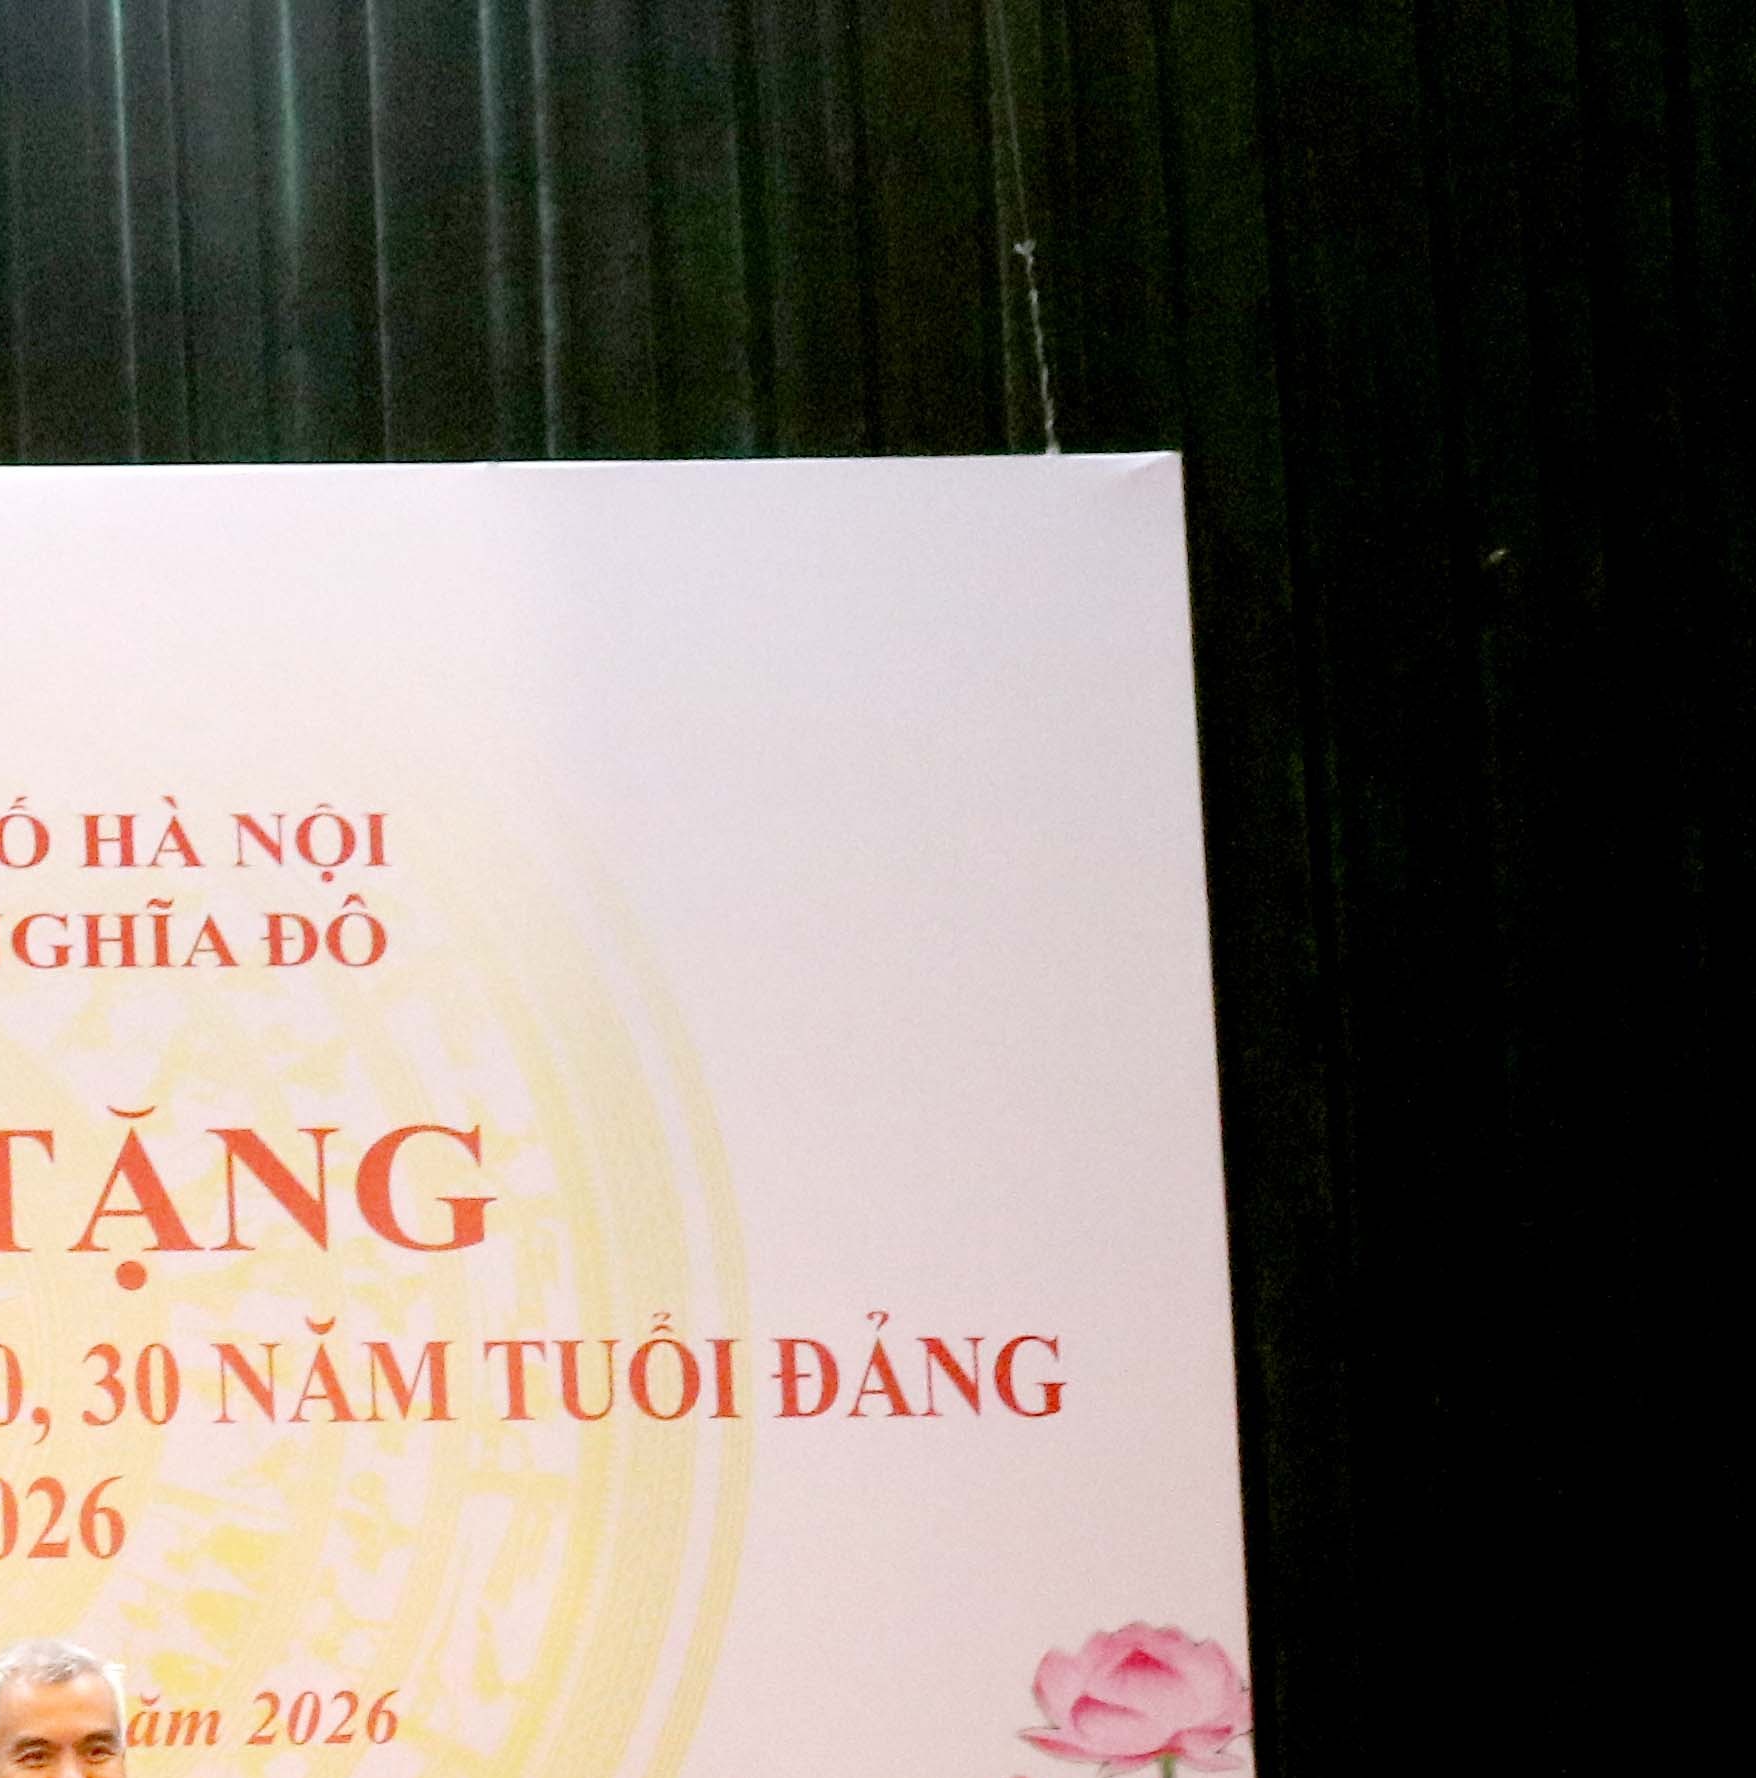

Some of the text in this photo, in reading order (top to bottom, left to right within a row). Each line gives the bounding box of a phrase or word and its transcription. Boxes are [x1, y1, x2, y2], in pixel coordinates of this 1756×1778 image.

[81, 795, 204, 870] HÀ
[234, 802, 389, 882] NỘI
[261, 892, 390, 969] ĐÔ
[82, 1343, 182, 1428] 30
[213, 1317, 455, 1427] NĂM
[482, 1312, 742, 1424] TUỔI
[773, 1312, 1067, 1421] ĐẢNG
[126, 1696, 221, 1748] ăm
[246, 1690, 400, 1747] 2026
